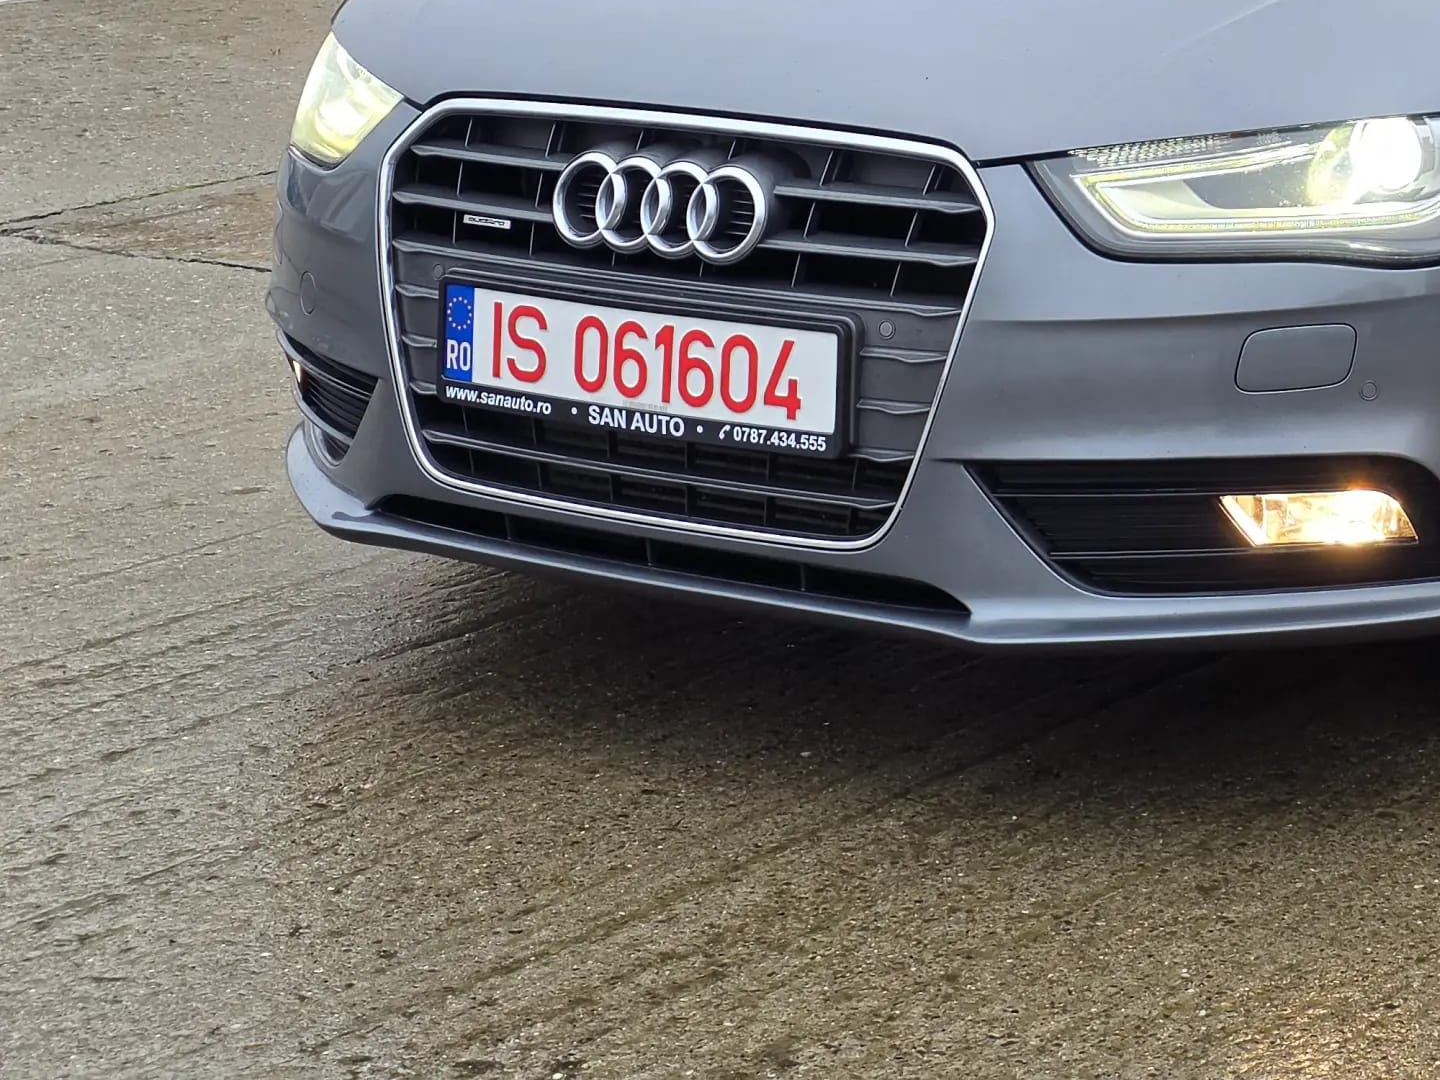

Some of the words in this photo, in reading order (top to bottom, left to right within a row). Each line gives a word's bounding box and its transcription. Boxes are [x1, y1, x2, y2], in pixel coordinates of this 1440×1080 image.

[446, 338, 472, 372] RO
[491, 300, 548, 383] IS
[573, 315, 802, 422] 061604
[445, 385, 552, 415] www.sanauto.ro
[588, 405, 627, 430] SAN
[630, 410, 685, 437] AUTO
[732, 425, 827, 452] 0787.434.555
